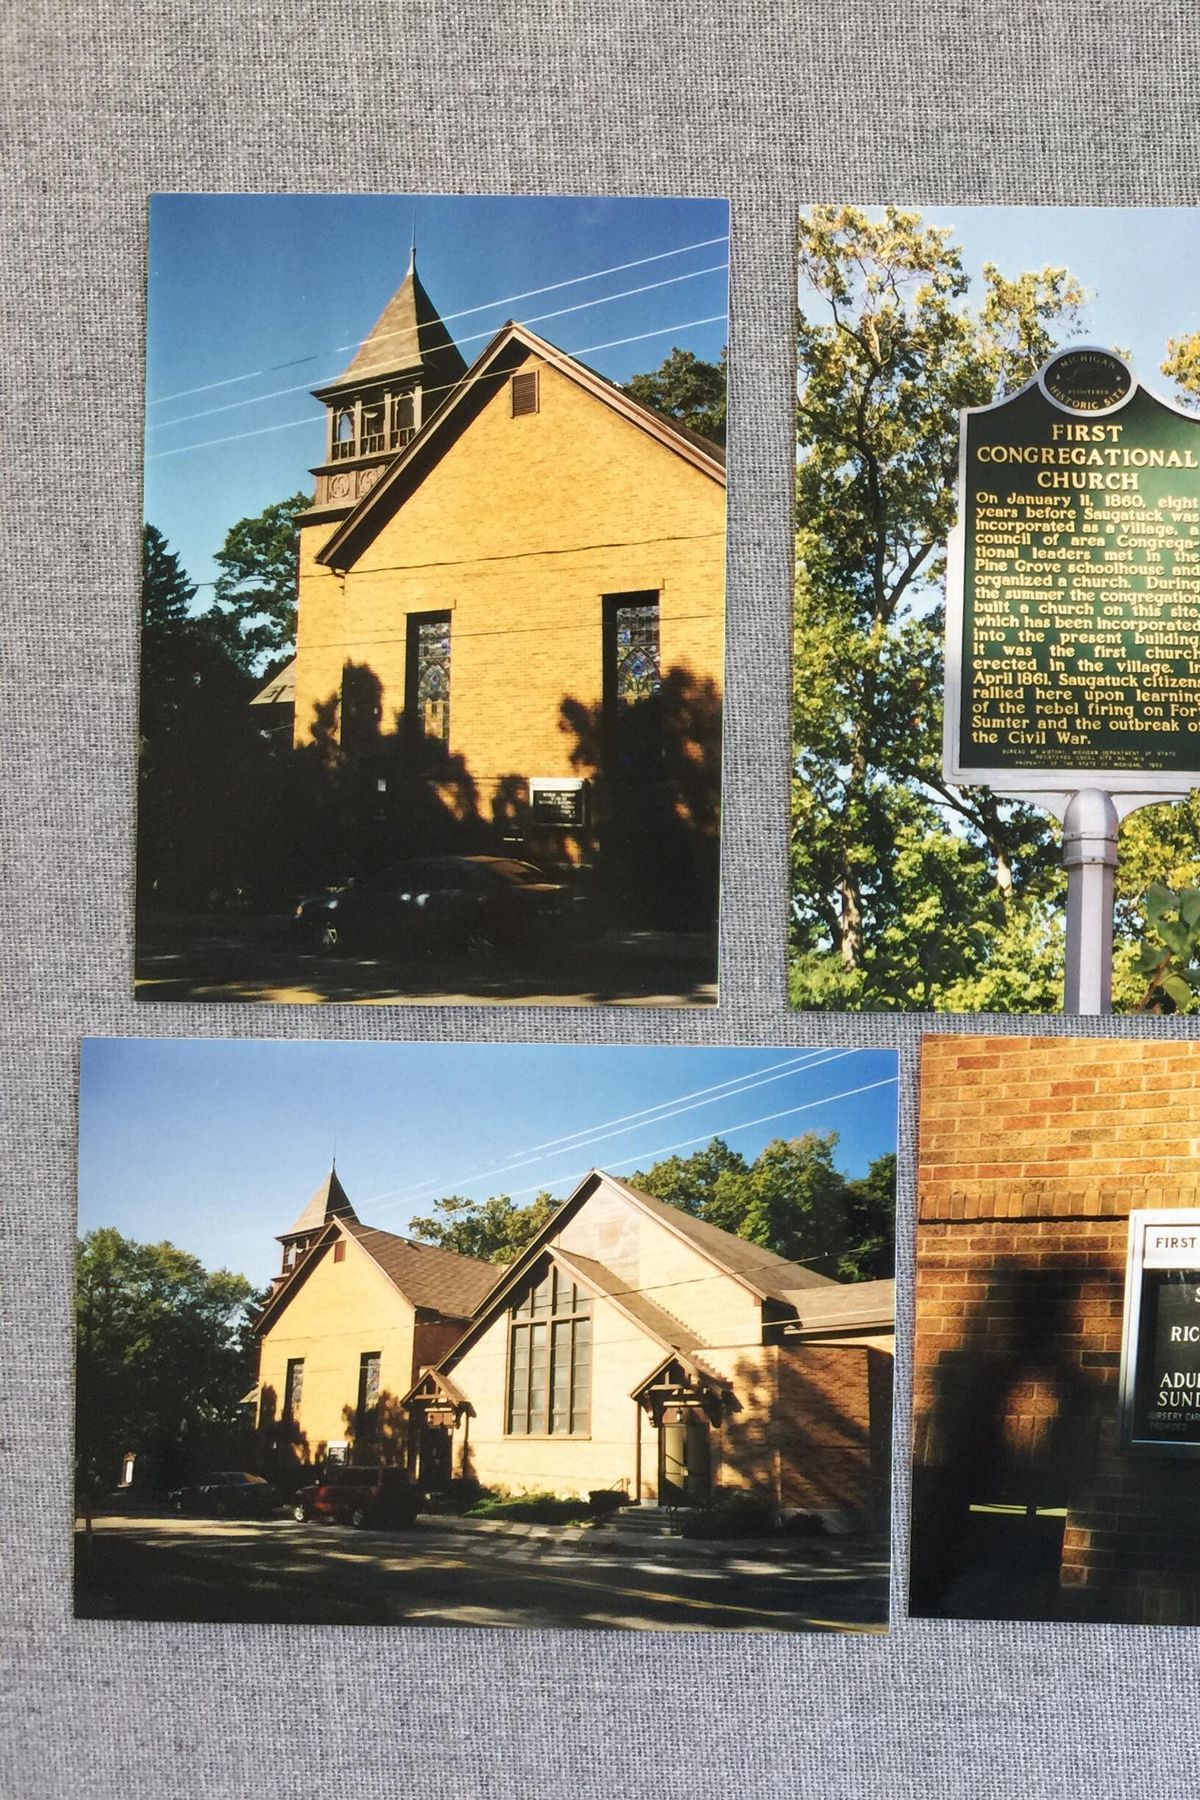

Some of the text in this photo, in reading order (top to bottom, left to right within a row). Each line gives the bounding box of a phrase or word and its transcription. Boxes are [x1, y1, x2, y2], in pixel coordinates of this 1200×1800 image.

[1060, 354, 1116, 369] MICHIGAN
[1050, 385, 1125, 410] HISTORIC SITE
[1052, 424, 1123, 442] FIRST
[977, 447, 1198, 468] CONGREGATIONAL
[1037, 472, 1139, 490] CHURCH
[976, 491, 998, 504] On
[1007, 492, 1071, 508] January
[1158, 496, 1199, 511] eight
[976, 506, 1200, 524] years before Saugatuck was
[975, 519, 1075, 533] incorporated
[1082, 524, 1098, 533] as
[1106, 524, 1115, 533] a
[1190, 526, 1199, 535] a
[975, 533, 1200, 551] council of area Congrega-
[975, 546, 1200, 562] tional leaders met in the
[975, 559, 1200, 576] Pine Grove schoolhouse and
[975, 574, 1200, 593] organized a church. During
[975, 587, 1200, 606] the summer the congregation
[974, 600, 1010, 613] built
[1020, 604, 1029, 613] a
[1039, 602, 1094, 615] church
[1104, 606, 1123, 616] on
[1132, 604, 1161, 617] this
[974, 614, 1019, 627] which
[1024, 616, 1050, 628] has
[1055, 616, 1092, 629] been
[973, 628, 1006, 641] into
[1018, 630, 1045, 642] the
[1060, 632, 1122, 645] present
[973, 642, 985, 655] It
[1003, 646, 1032, 656] was
[1049, 645, 1075, 657] the
[1094, 646, 1127, 658] first
[973, 659, 1037, 670] erected
[1050, 659, 1065, 671] in
[1078, 659, 1104, 672] the
[1117, 660, 1174, 676] village.
[973, 671, 1013, 686] April
[1059, 673, 1138, 689] Saugatuck
[973, 686, 1024, 699] rallied
[1036, 687, 1072, 700] here
[1084, 690, 1124, 703] upon
[972, 701, 989, 713] of
[999, 702, 1025, 714] the
[1036, 702, 1079, 715] rebel
[1088, 703, 1134, 718] firing
[1144, 706, 1163, 717] on
[972, 715, 1030, 728] Sumter
[1038, 717, 1067, 729] and
[1075, 718, 1101, 730] the
[1109, 718, 1180, 731] outbreak
[972, 731, 1091, 745] the Civil War.
[1156, 1237, 1197, 1249] FIRST
